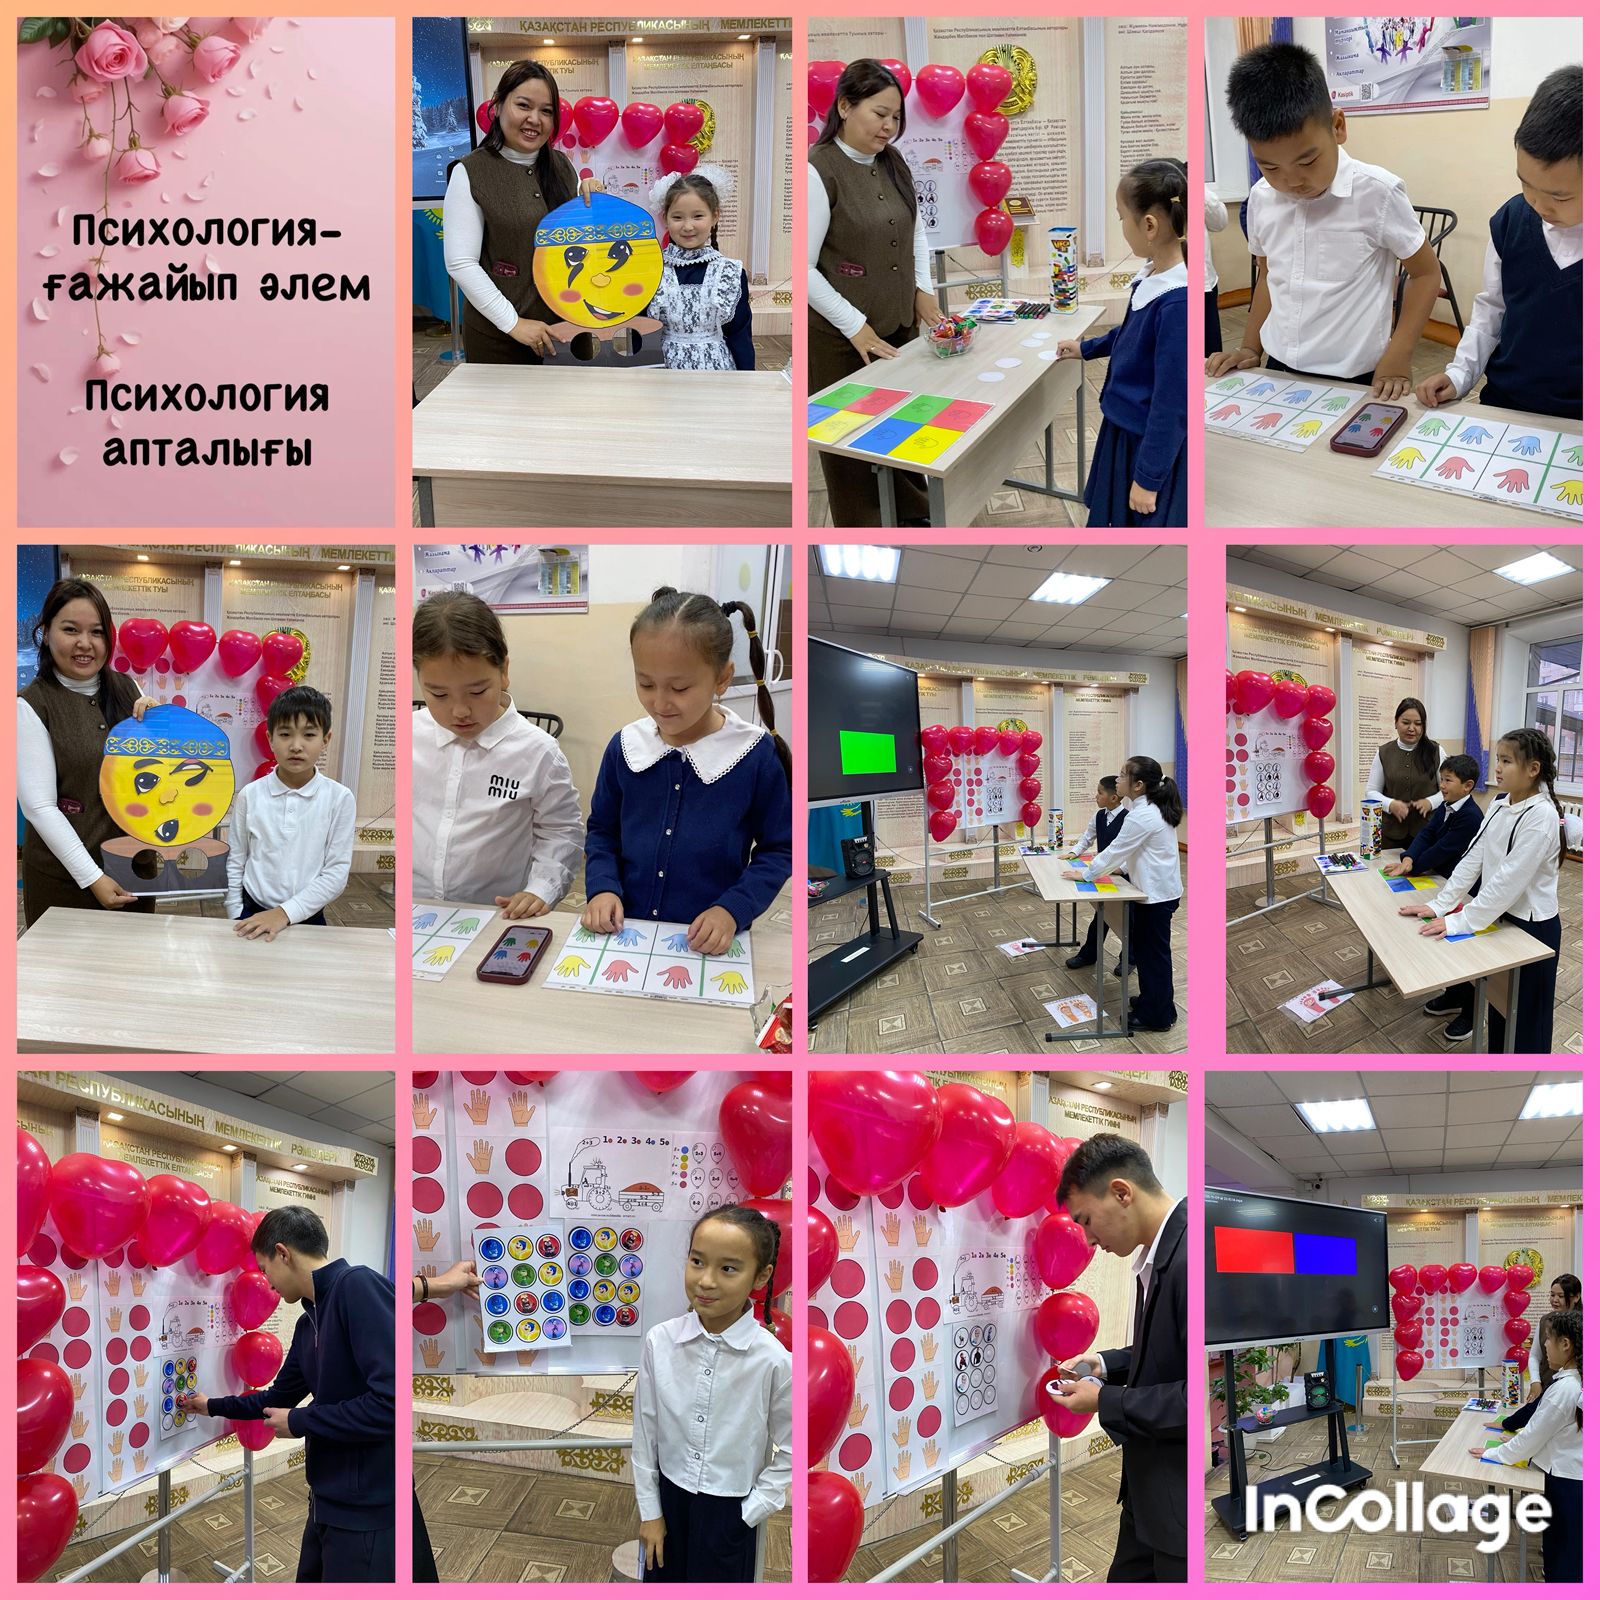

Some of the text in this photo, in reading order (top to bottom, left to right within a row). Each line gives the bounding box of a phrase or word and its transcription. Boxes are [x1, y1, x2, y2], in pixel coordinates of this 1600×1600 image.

[520, 20, 587, 33] ҚАЗАҚСТАН
[1048, 1095, 1080, 1111] АЗАҚСТАН
[617, 1136, 623, 1144] 2
